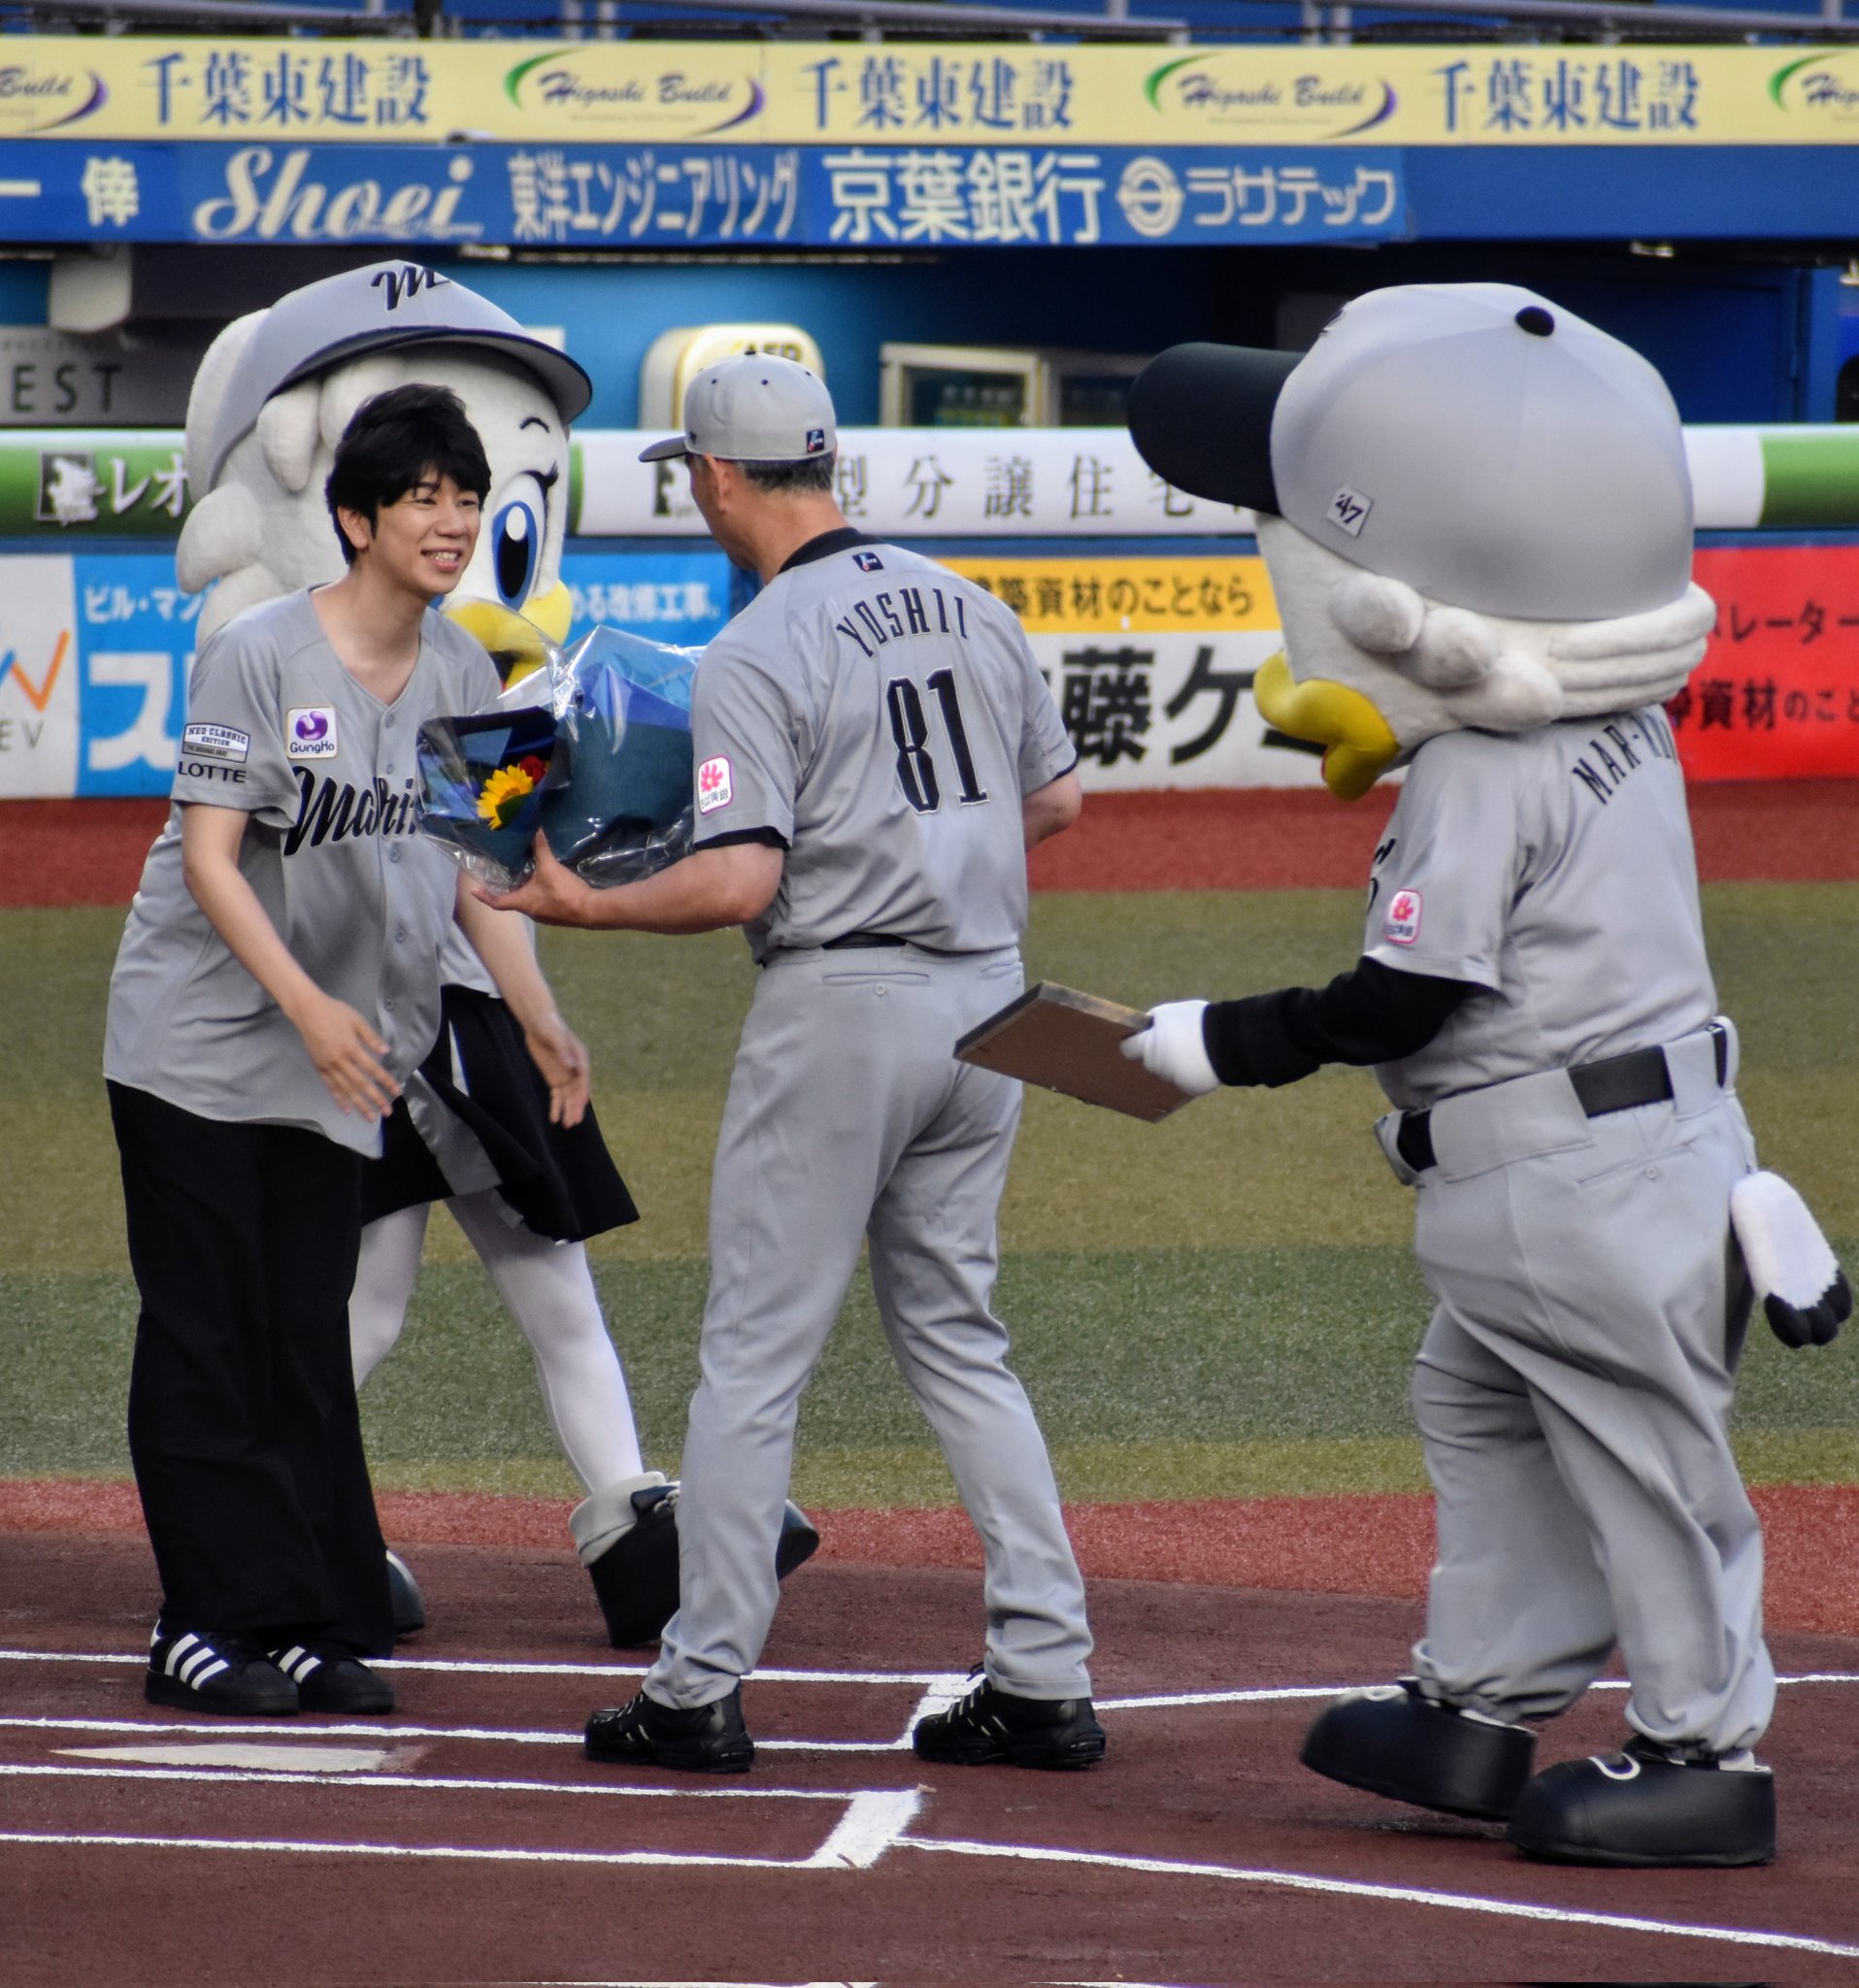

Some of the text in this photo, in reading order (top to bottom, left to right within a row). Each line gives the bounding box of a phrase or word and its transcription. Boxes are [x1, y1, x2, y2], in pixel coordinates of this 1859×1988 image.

[139, 51, 430, 126] 千葉東建設
[655, 70, 731, 104] Build
[798, 56, 1074, 130] 千葉東建設
[1293, 74, 1367, 107] Build
[1430, 59, 1700, 133] 千葉東建設
[193, 147, 482, 239] Shoei
[822, 148, 1105, 243] 京葉銀行
[836, 587, 968, 658] YOSHII
[975, 575, 1255, 619] 築資材のことなら
[178, 760, 248, 784] LOTTE
[289, 742, 335, 754] GungHo
[887, 666, 989, 814] 81
